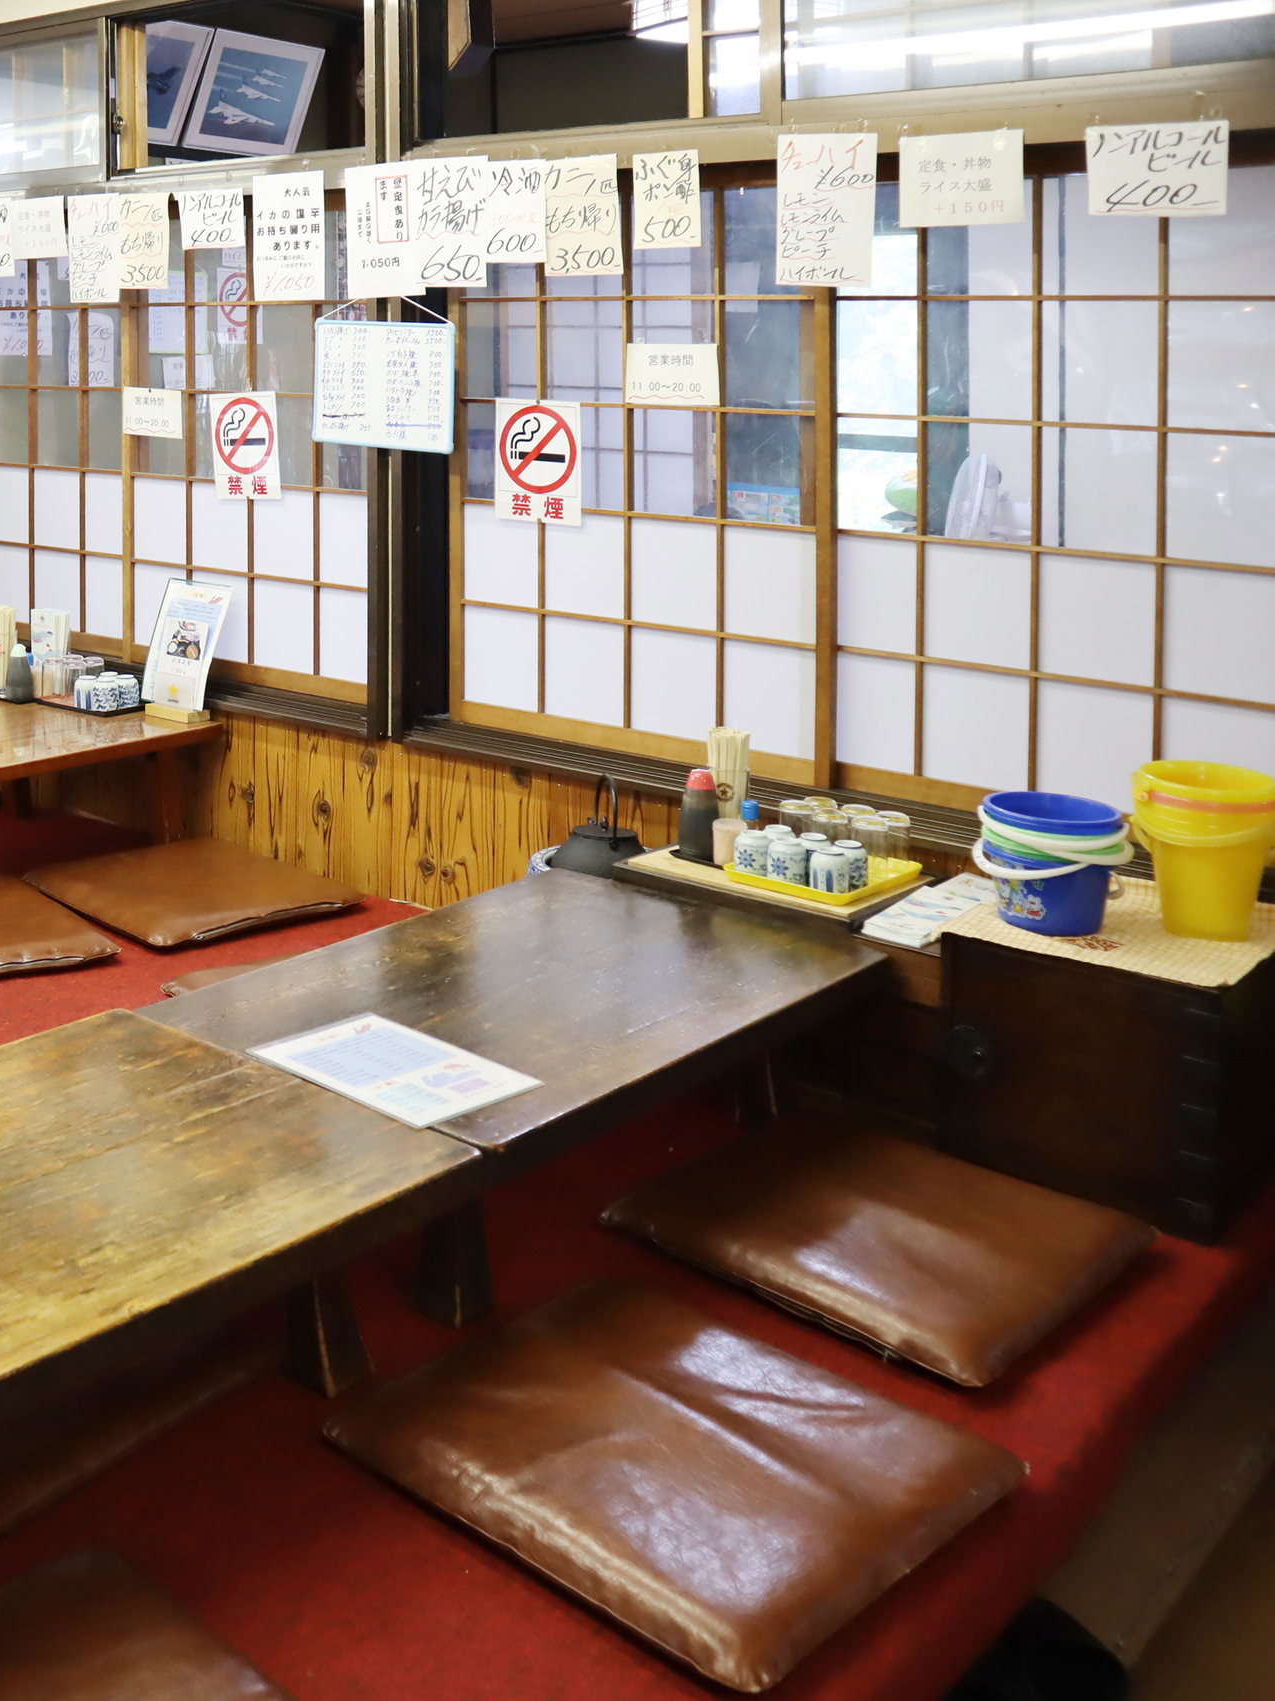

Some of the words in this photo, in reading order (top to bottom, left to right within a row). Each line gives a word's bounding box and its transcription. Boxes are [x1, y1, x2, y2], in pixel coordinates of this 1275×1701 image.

[1148, 150, 1223, 173] ビール
[416, 164, 481, 206] 甘えび
[489, 166, 541, 197] 冷酒
[920, 178, 993, 195] ライス大盛
[284, 186, 311, 198] 大人気
[379, 180, 389, 202] ます
[784, 193, 830, 207] レモン
[202, 210, 238, 226] ビール
[256, 207, 321, 221] イカの塩辛
[17, 223, 52, 235] ライス大盛
[256, 223, 321, 237] お持ち帰り用
[781, 226, 836, 245] グレープ
[782, 243, 832, 259] ピーチ
[780, 265, 858, 281] ハイボール
[649, 354, 694, 367] 営業時間
[134, 396, 165, 408] 営業時間
[227, 475, 268, 496] 禁煙
[511, 493, 564, 520] 禁煙
